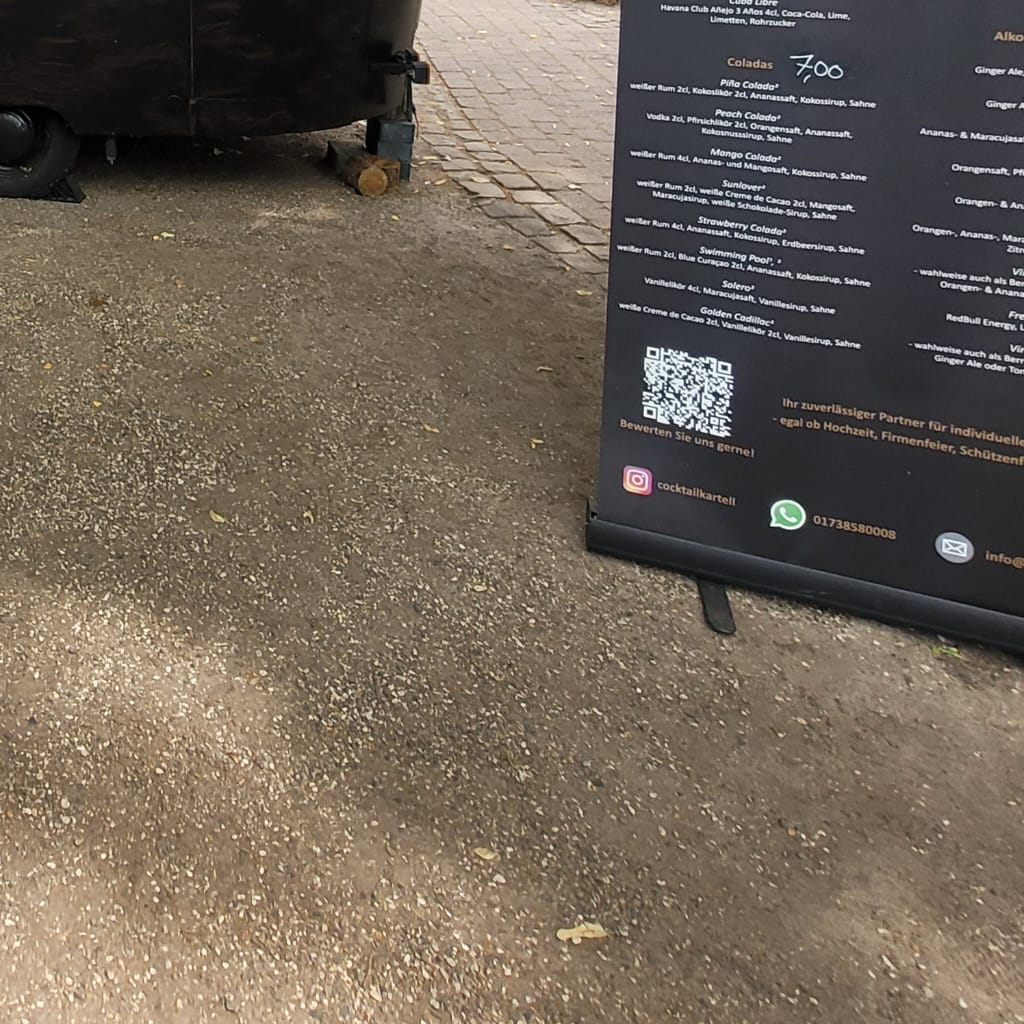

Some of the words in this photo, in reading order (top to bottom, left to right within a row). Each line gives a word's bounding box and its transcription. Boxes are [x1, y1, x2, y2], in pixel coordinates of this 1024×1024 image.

[710, 16, 748, 25] Limetten,
[750, 18, 796, 27] Rohrzucker
[727, 58, 773, 69] Coladas
[789, 54, 844, 83] 7,00
[975, 66, 1006, 76] Ginger
[720, 79, 741, 88] Piña
[715, 109, 743, 119] Peach
[710, 148, 744, 160] Mango
[951, 164, 1011, 176] Orangensaft,
[697, 216, 749, 232] Strawberry
[699, 246, 747, 262] Swimming
[644, 277, 686, 290] Vanillelikör
[703, 287, 757, 304] Maracujasaft,
[758, 297, 809, 312] Vanillesirup,
[810, 305, 836, 315] Sahne
[700, 307, 733, 319] Golden
[946, 313, 981, 325] RedBull
[783, 398, 799, 409] Ihr
[801, 402, 876, 420] zuverlässiger
[879, 412, 926, 428] Partner
[928, 420, 948, 432] für
[620, 419, 672, 438] Bewerten
[675, 431, 692, 443] Sie
[694, 437, 715, 448] uns
[780, 417, 803, 428] egal
[806, 419, 821, 430] ob
[823, 421, 878, 440] Hochzeit,
[881, 431, 956, 455] Firmenfeier,
[657, 482, 736, 506] cocktailkartell
[813, 515, 896, 540] 01738580008
